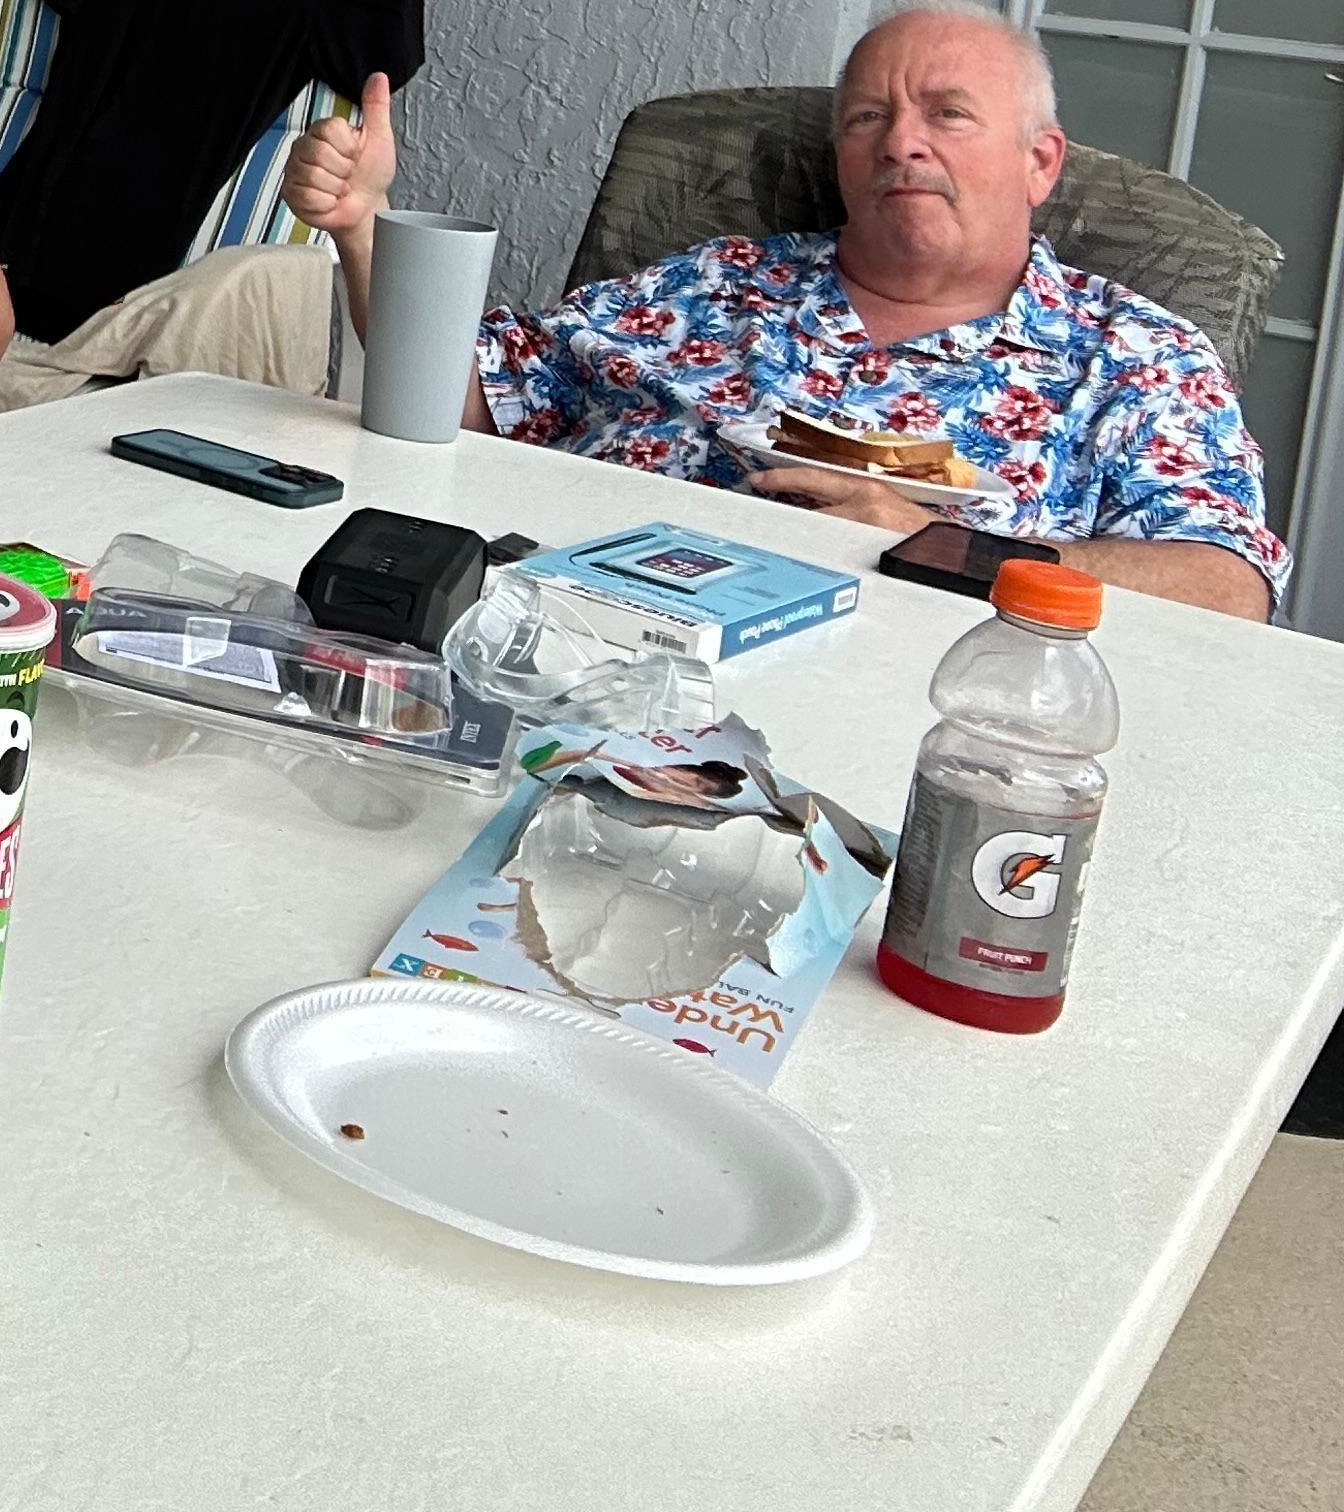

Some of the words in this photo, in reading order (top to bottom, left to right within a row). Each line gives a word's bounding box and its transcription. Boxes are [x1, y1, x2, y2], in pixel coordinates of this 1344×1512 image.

[972, 831, 1068, 919] G
[977, 946, 1004, 962] FRUIT
[1004, 952, 1032, 966] PUNCH
[756, 993, 794, 1015] FUN
